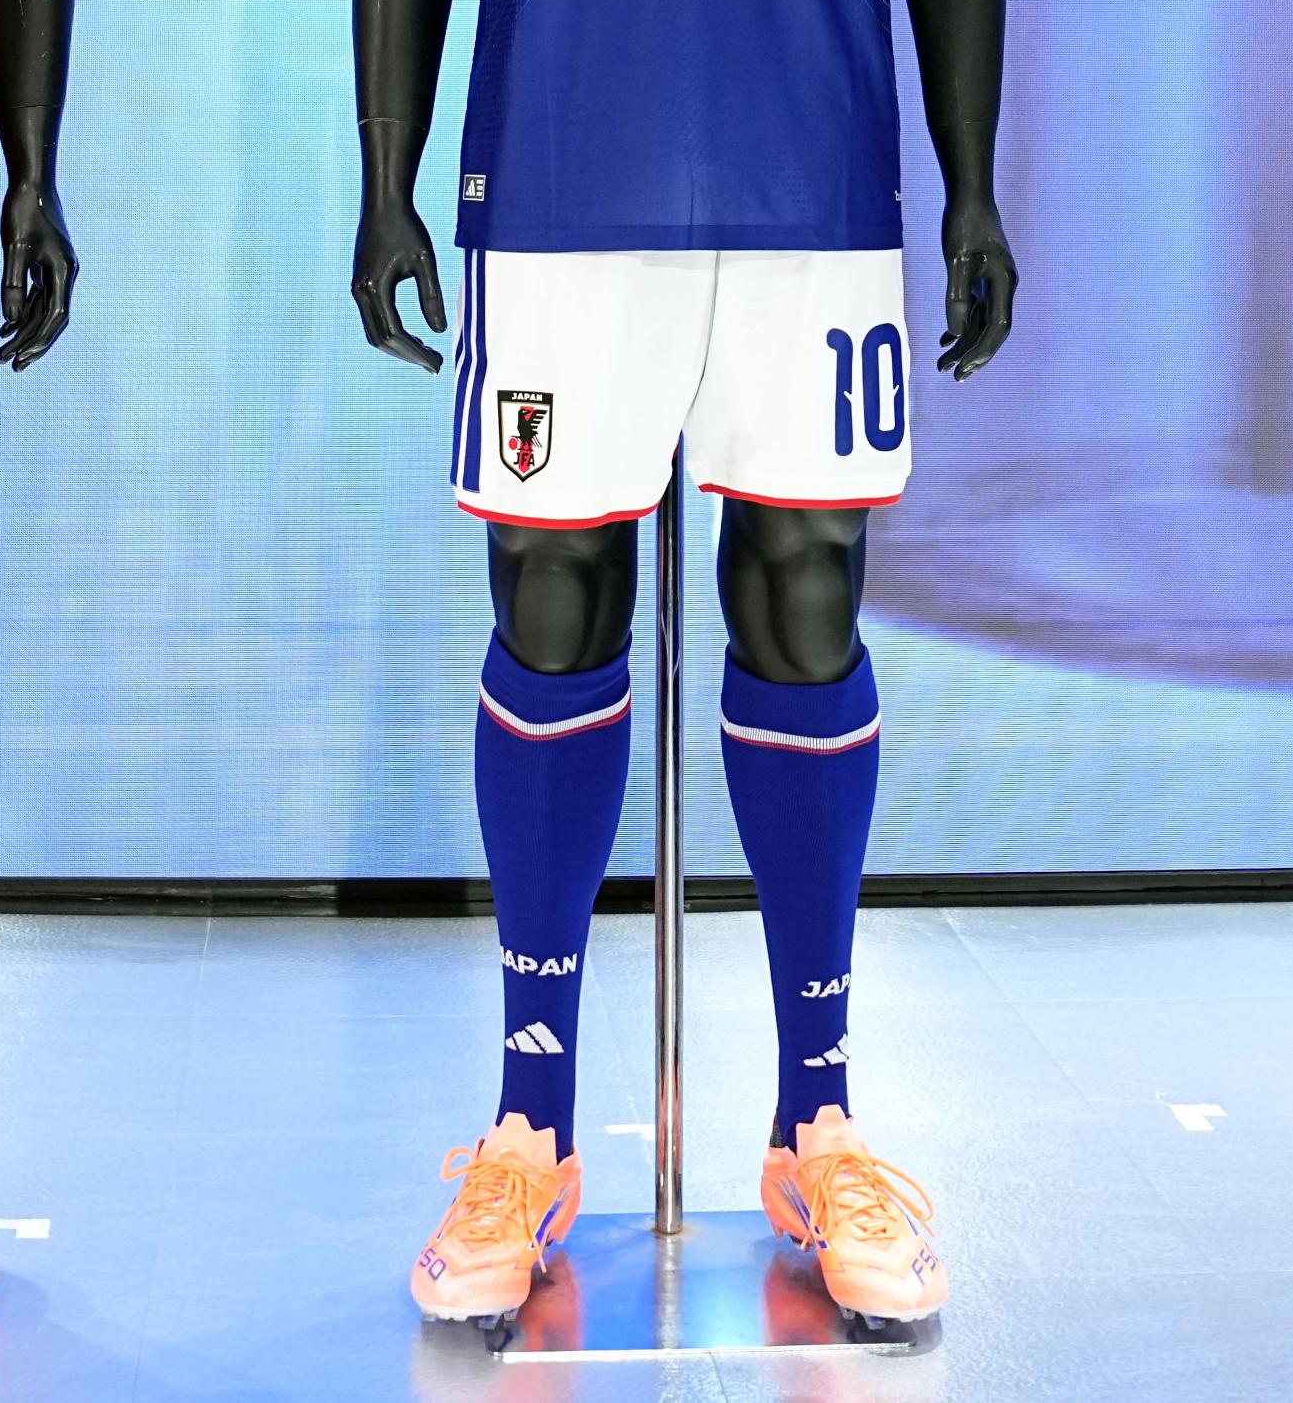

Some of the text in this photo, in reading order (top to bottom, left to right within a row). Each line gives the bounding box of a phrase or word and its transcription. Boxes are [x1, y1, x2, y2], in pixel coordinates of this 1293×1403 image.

[511, 392, 543, 402] JAPAN
[826, 322, 905, 457] 10
[513, 452, 535, 467] JFA
[801, 972, 851, 998] JAP
[419, 1245, 446, 1281] 50
[911, 1245, 938, 1286] F5
